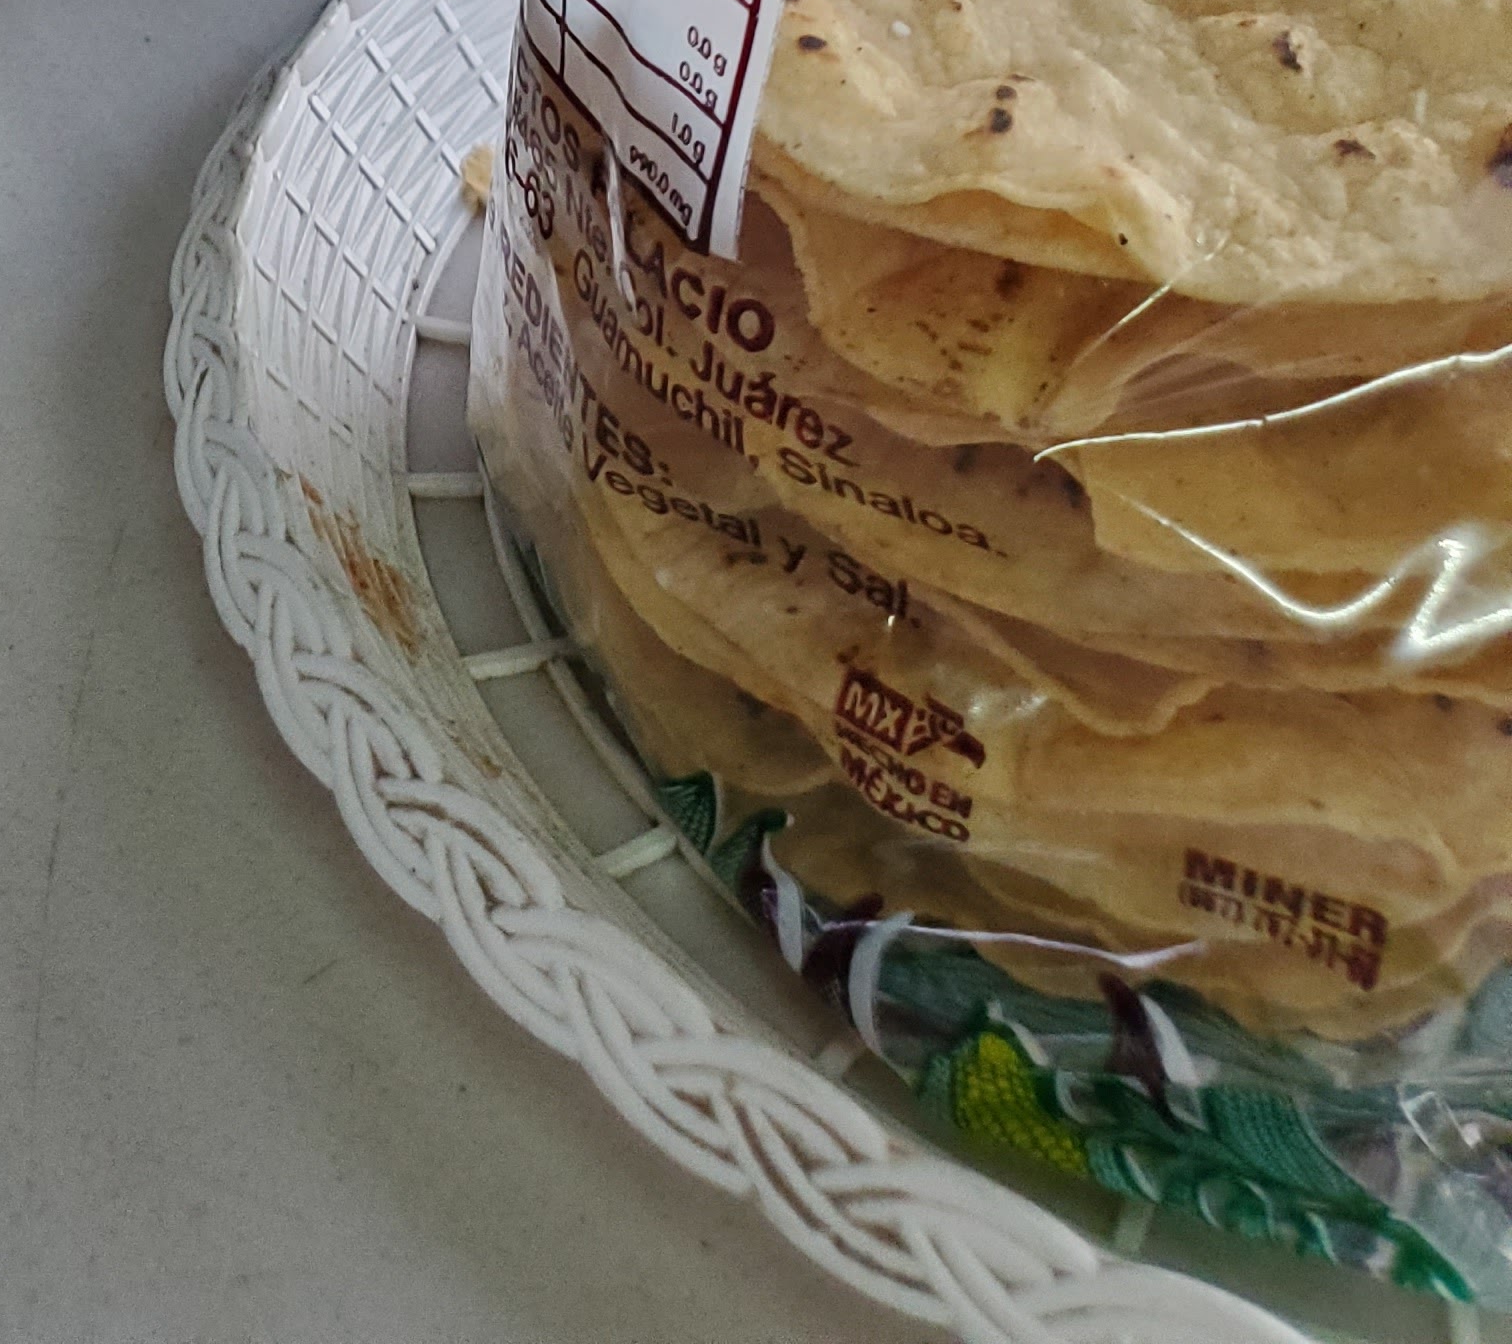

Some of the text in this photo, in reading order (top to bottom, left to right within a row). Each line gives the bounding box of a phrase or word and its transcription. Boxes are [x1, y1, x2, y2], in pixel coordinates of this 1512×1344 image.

[689, 340, 861, 469] Juárez
[581, 429, 762, 549] Vegetal
[779, 534, 808, 575] y
[827, 549, 922, 631] Sal.
[778, 445, 1011, 560] Sinaloa.
